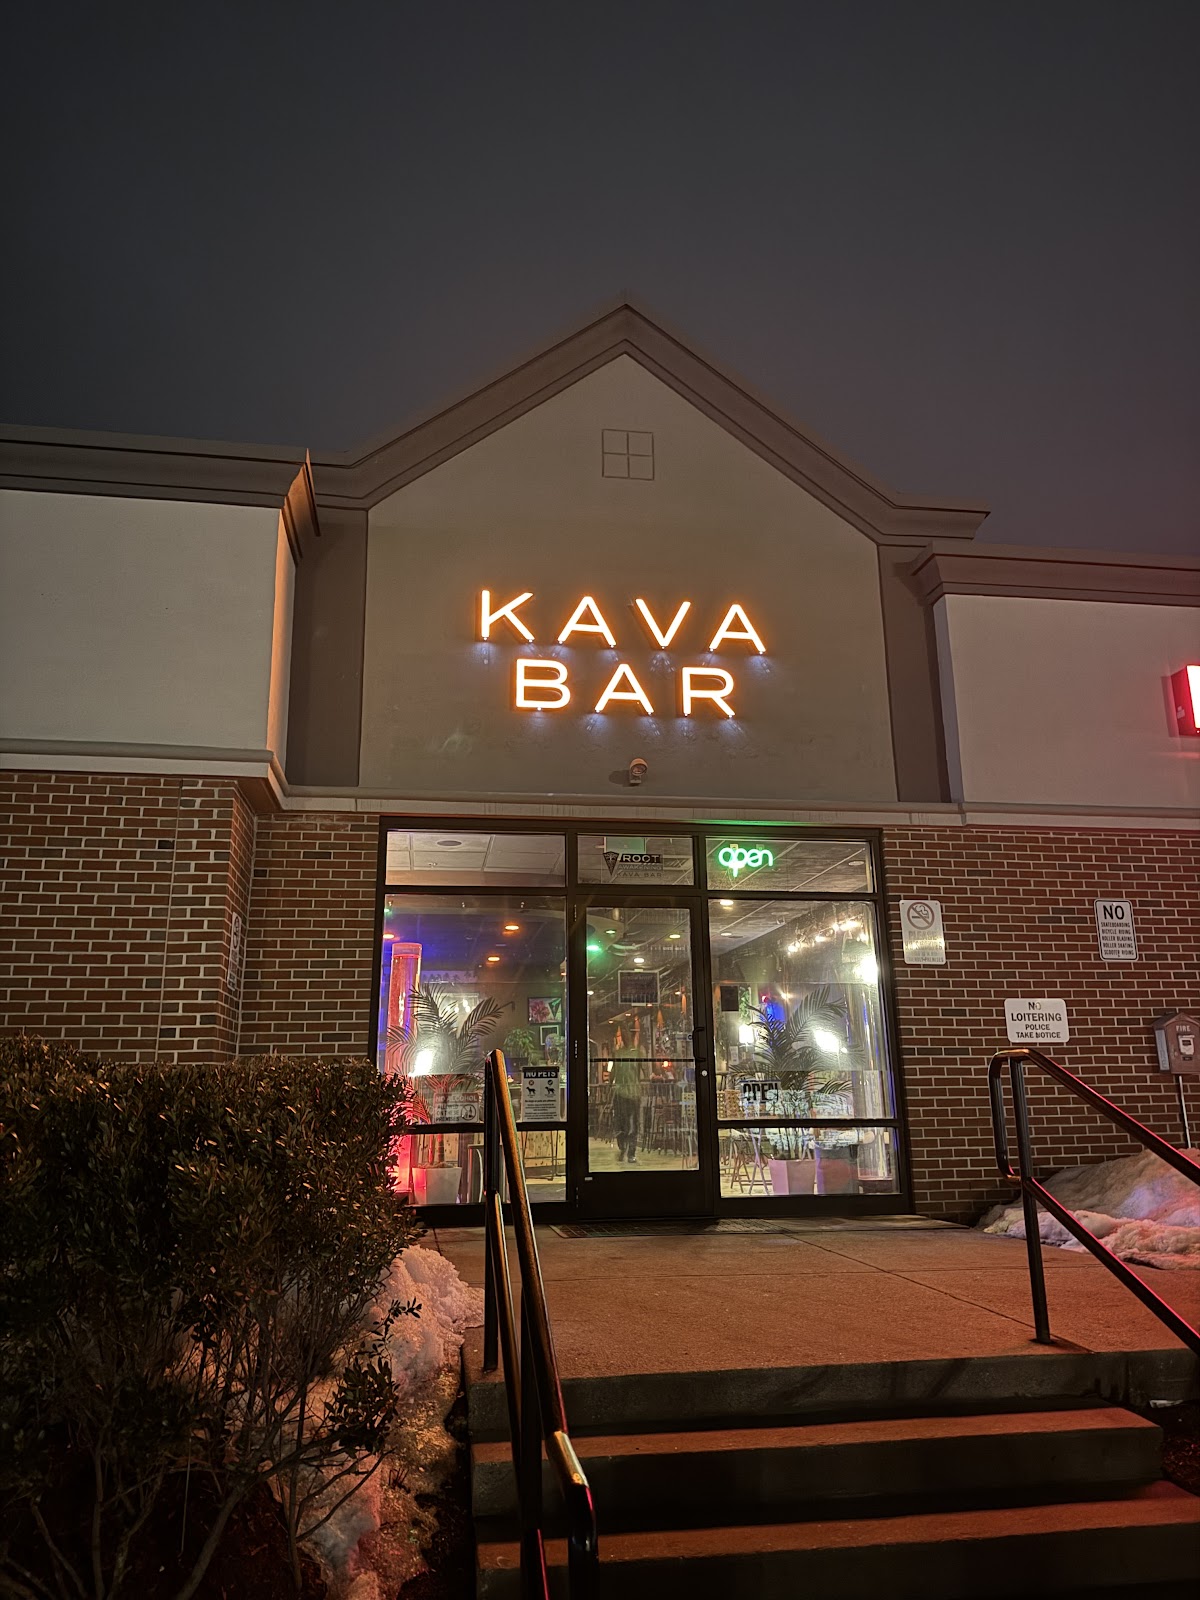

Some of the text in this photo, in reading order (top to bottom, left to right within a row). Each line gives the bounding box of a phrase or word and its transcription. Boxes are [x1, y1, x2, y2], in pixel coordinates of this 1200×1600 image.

[480, 589, 767, 654] KAVA
[515, 658, 736, 718] BAR
[622, 854, 660, 863] ROOT
[718, 847, 774, 878] open
[1103, 904, 1125, 920] NO
[1028, 1002, 1041, 1010] NO
[1011, 1013, 1062, 1021] LOITERING
